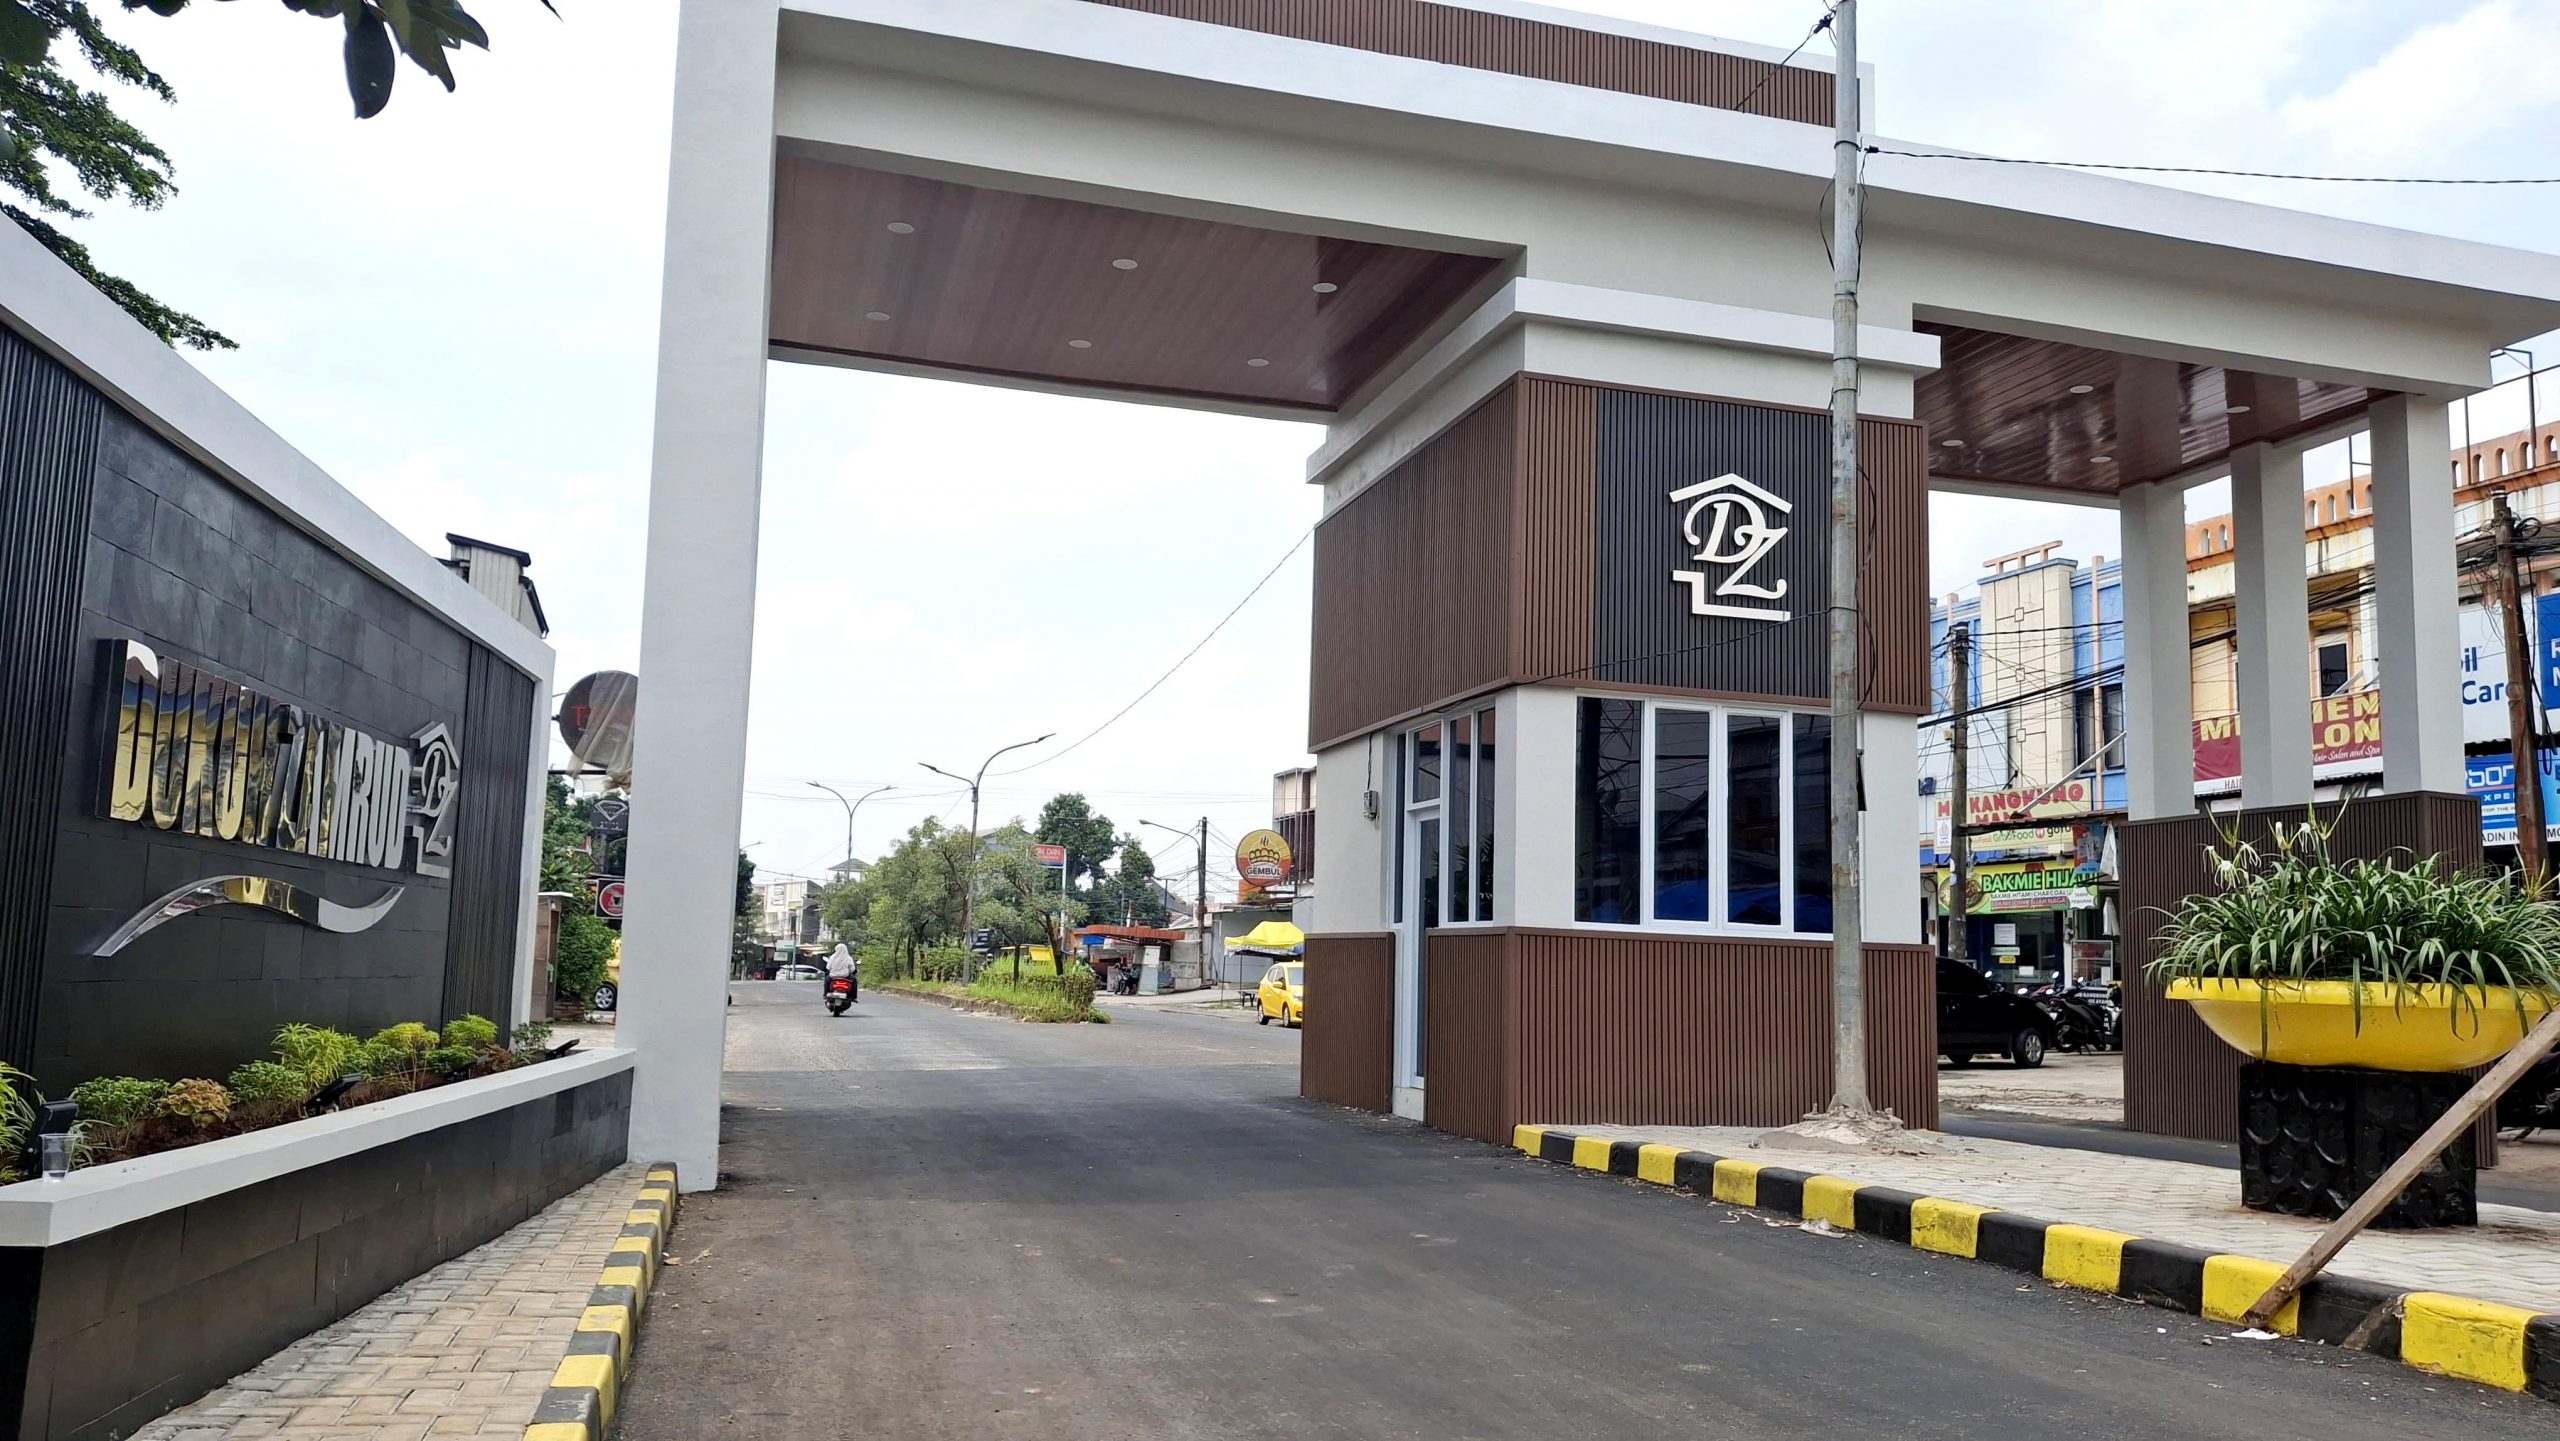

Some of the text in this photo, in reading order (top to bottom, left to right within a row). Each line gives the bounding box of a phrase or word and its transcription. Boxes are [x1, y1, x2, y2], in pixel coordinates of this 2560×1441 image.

[2462, 681, 2509, 705] Car
[1247, 867, 1283, 876] GEMBUL
[1982, 872, 2043, 893] BAKMIE
